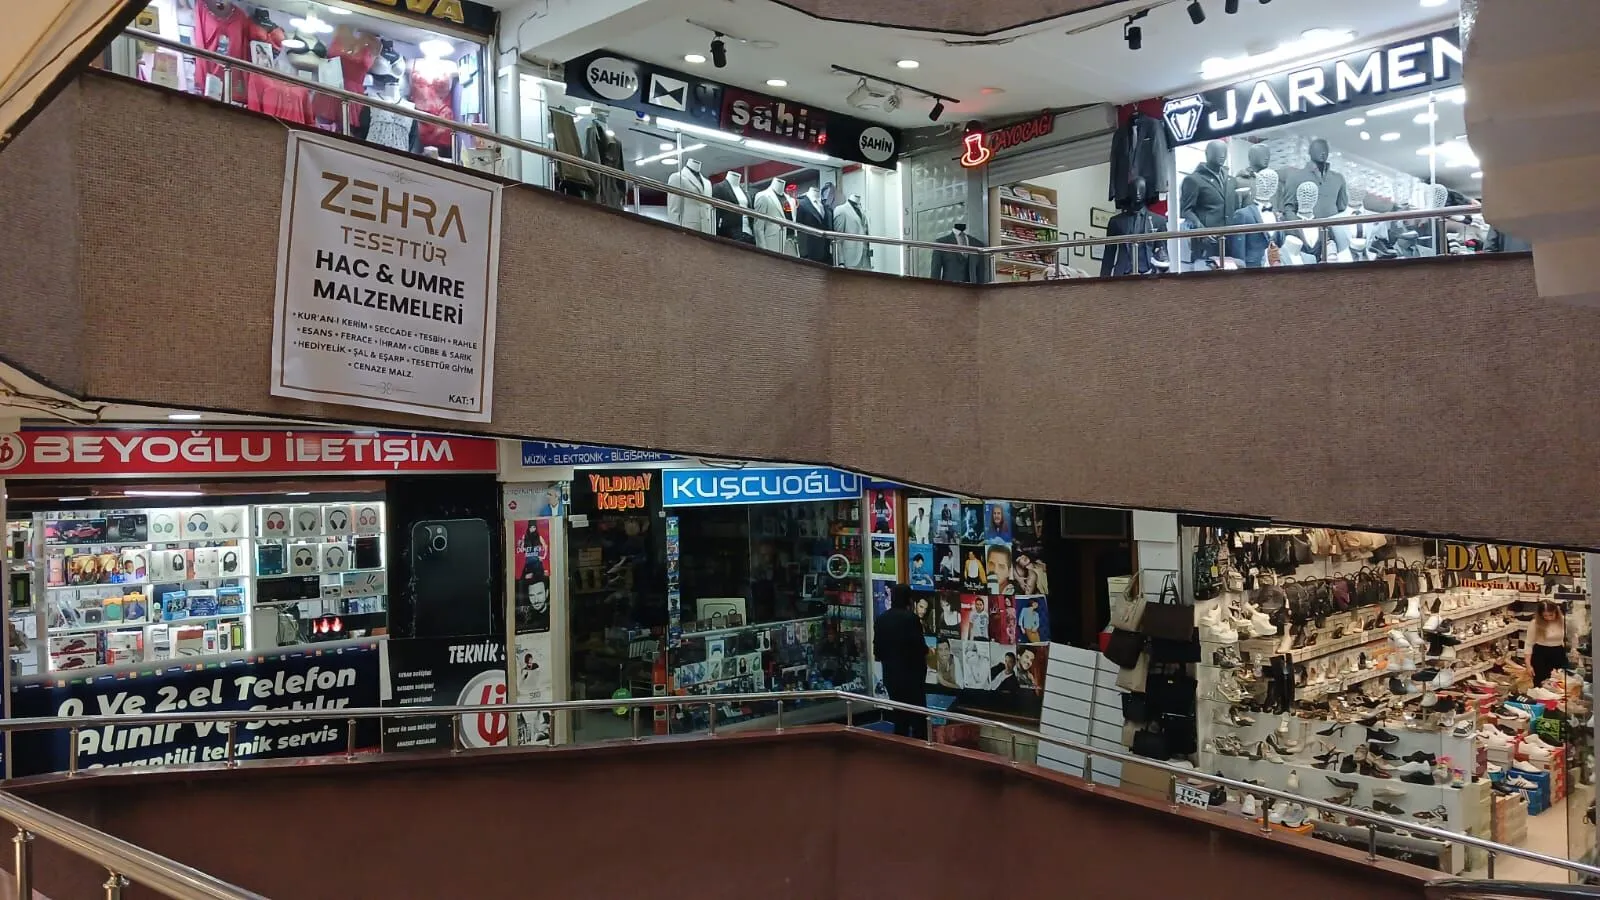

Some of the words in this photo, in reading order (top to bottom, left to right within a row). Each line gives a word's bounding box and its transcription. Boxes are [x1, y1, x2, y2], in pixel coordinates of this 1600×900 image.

[590, 67, 636, 89] ŞAHİN
[1208, 36, 1462, 130] JARMEN
[861, 135, 893, 153] ŞAHİN
[321, 171, 467, 243] ZEHRA
[341, 226, 448, 267] TESETTÜR
[315, 249, 370, 279] HAC
[376, 263, 394, 285] &
[401, 268, 465, 300] UMRE
[313, 279, 464, 325] MALZEMELERİ
[301, 326, 333, 338] ESANS
[340, 331, 373, 344] FERACE
[379, 337, 407, 351] İHRAM
[413, 344, 440, 356] CÜBBE
[441, 349, 448, 358] &
[449, 351, 472, 362] SARIK
[341, 318, 368, 330] KERİM
[374, 324, 412, 338] SECCADE
[419, 332, 446, 344] TESBİH
[452, 338, 478, 350] RAHLE
[298, 340, 346, 354] HEDİYELİK
[353, 347, 368, 358] ŞAL
[370, 351, 377, 359] &
[378, 352, 405, 363] EŞARP
[411, 357, 450, 371] TESETTÜR
[451, 363, 474, 375] GİYİM
[353, 361, 387, 374] CENAZE
[388, 367, 414, 378] MALZ.
[34, 430, 274, 463] BEYOĞLU
[285, 431, 454, 470] İLETİŞİM
[524, 453, 547, 465] MÜZİK
[553, 450, 604, 464] ELEKTRONİK
[588, 472, 652, 493] YILDIRAY
[672, 471, 858, 500] KUŞCUOĞLU
[1446, 543, 1573, 577] DAMLA
[448, 639, 499, 664] TEKNİK
[96, 691, 146, 716] Ve
[155, 678, 223, 713] 2.el
[234, 666, 357, 701] Telefon
[78, 721, 182, 757] Alınır
[277, 724, 338, 749] servis
